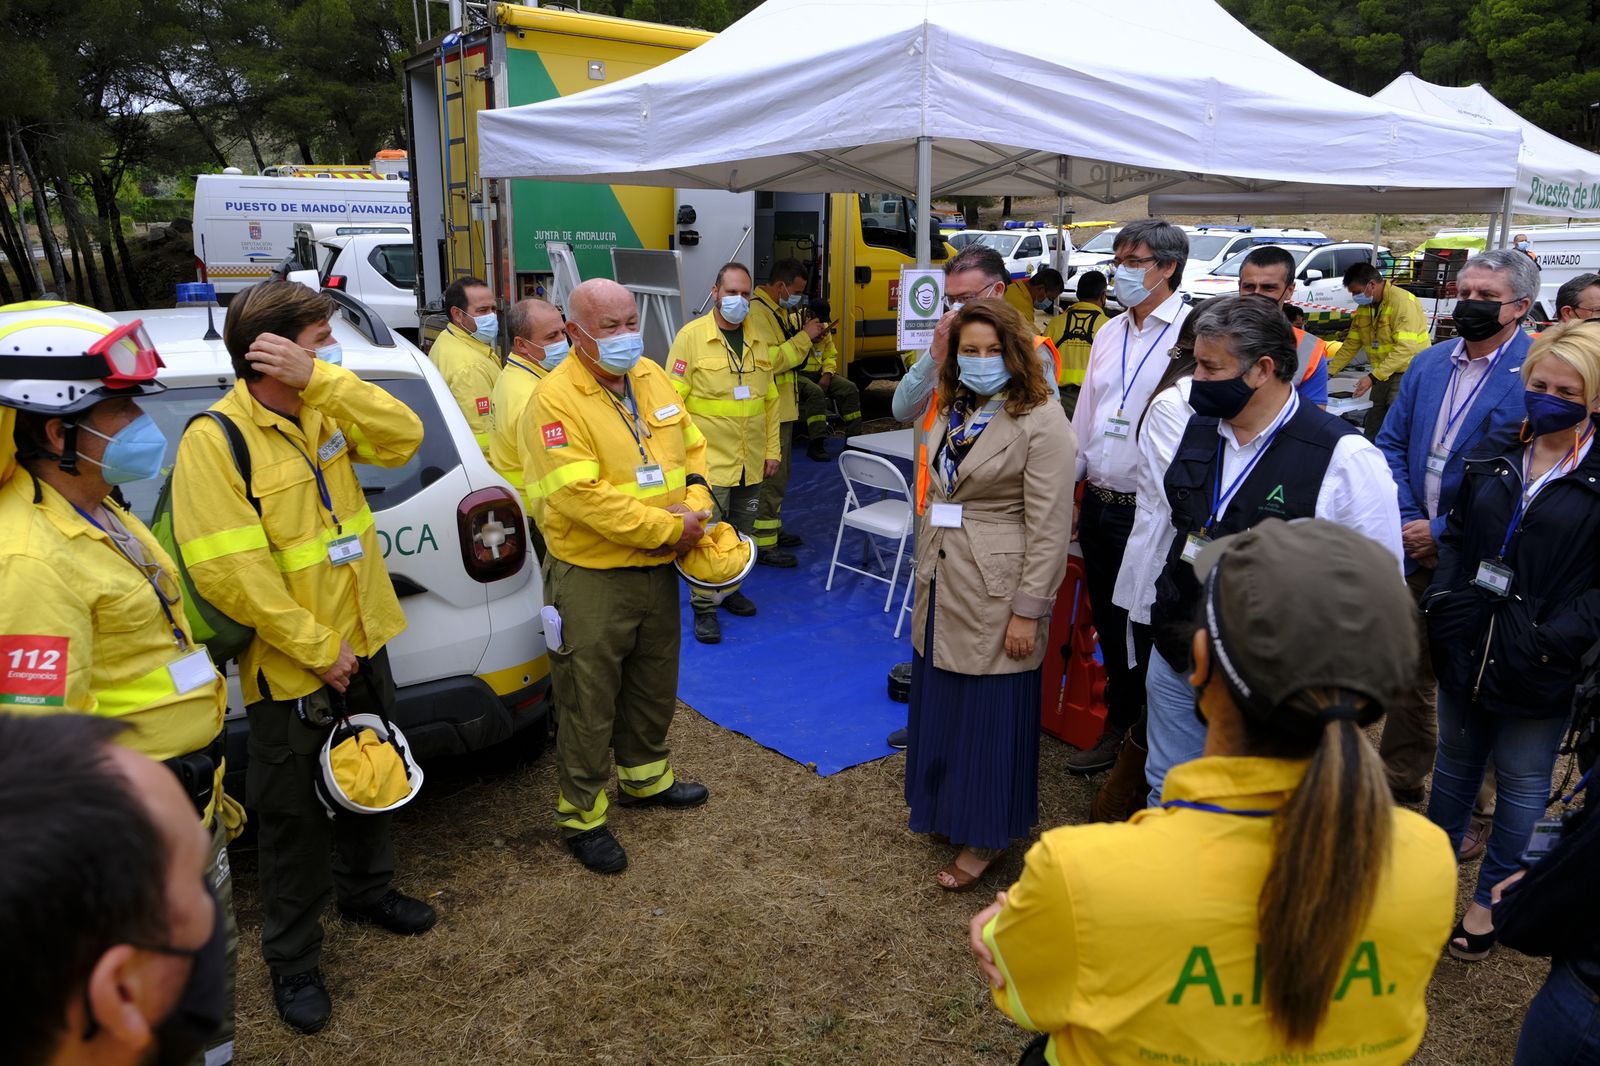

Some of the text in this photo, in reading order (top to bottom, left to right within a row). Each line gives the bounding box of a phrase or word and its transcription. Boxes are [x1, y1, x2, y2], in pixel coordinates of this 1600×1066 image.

[1528, 176, 1570, 208] Puesto
[1572, 182, 1588, 209] de
[225, 201, 412, 215] PUESTO DE MANDO AVANZADO
[534, 230, 560, 240] JUNTA
[563, 231, 572, 240] DE
[1542, 255, 1580, 265] AVANZADO
[545, 427, 562, 438] 112
[8, 648, 60, 670] 112
[8, 670, 58, 680] Emergencias
